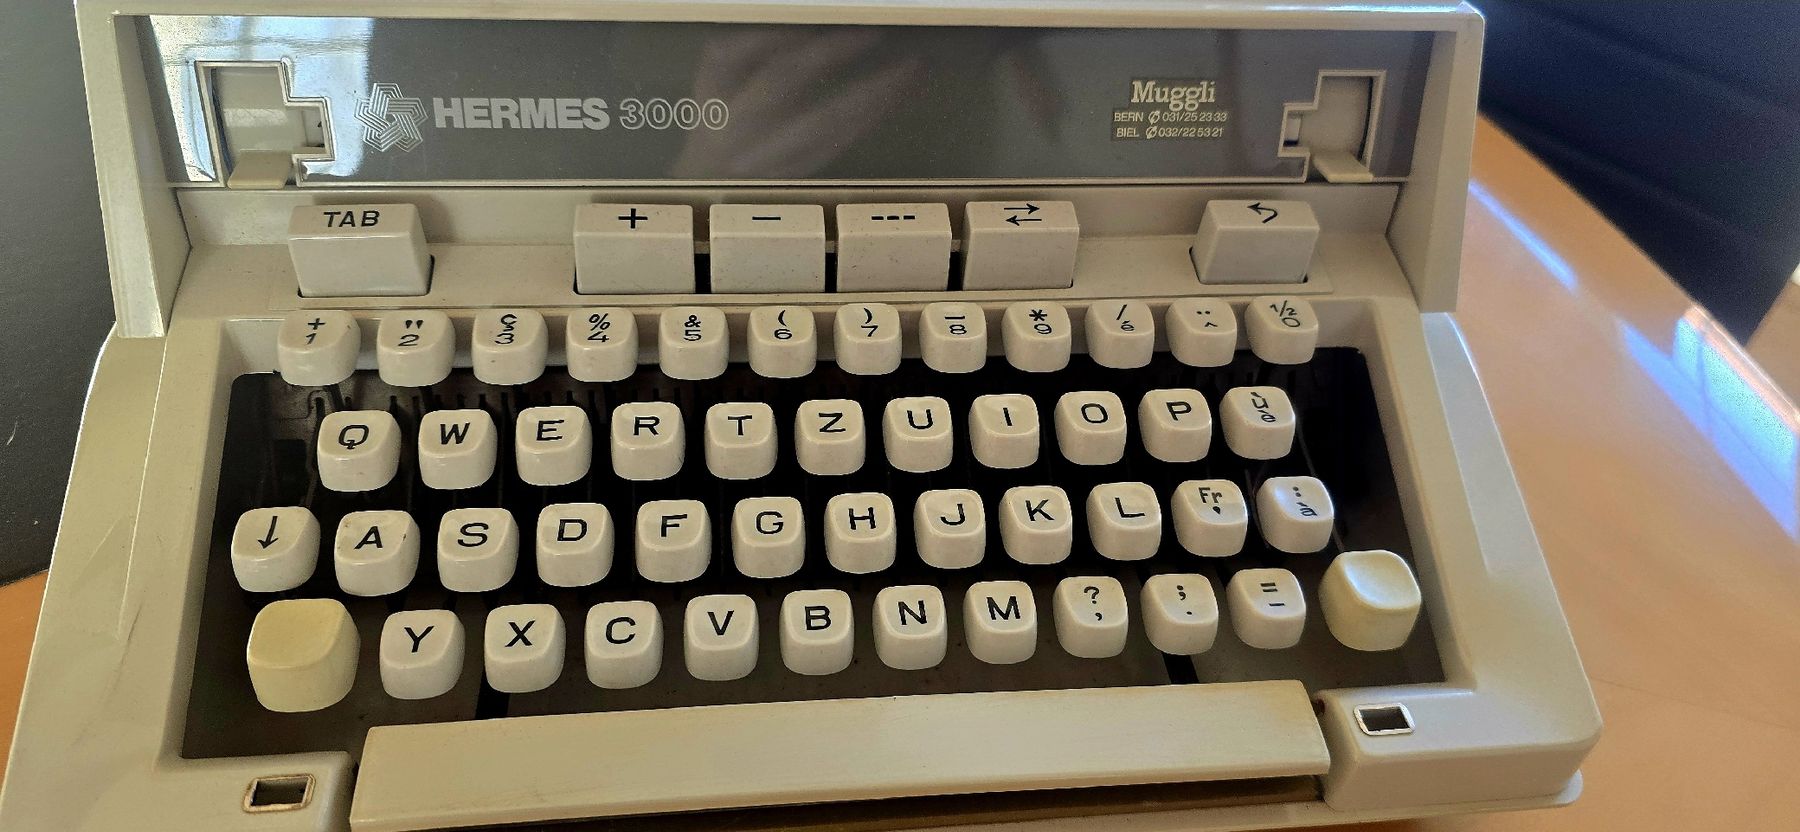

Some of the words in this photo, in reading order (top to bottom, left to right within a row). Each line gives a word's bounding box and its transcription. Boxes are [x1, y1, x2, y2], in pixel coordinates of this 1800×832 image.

[1130, 79, 1216, 112] Muggli
[432, 96, 611, 130] HERMES
[619, 96, 730, 131] 3000
[1113, 111, 1144, 122] BERN
[1116, 127, 1140, 138] BIEL
[324, 211, 379, 227] TAB
[589, 313, 610, 331] %
[684, 315, 701, 327] &
[861, 325, 878, 337] 7
[949, 325, 967, 335] 8
[1034, 324, 1052, 334] 9
[1118, 319, 1134, 331] é
[306, 333, 316, 344] 1
[398, 334, 419, 346] 2
[495, 331, 514, 344] 3
[588, 330, 609, 342] 4
[684, 330, 701, 341] 5
[774, 329, 792, 339] 6
[907, 409, 933, 429] U
[1003, 408, 1012, 426] I
[1081, 404, 1108, 423] O
[1166, 402, 1191, 421] P
[537, 420, 564, 441] E
[633, 416, 660, 435] R
[728, 415, 752, 435] T
[819, 413, 846, 432] Z
[339, 425, 369, 449] Q
[440, 423, 470, 444] W
[1199, 488, 1222, 507] Fr
[941, 504, 965, 525] J
[1026, 500, 1054, 521] K
[1115, 498, 1145, 518] L
[661, 514, 687, 537] F
[756, 511, 783, 534] G
[849, 507, 876, 530] H
[354, 526, 382, 549] A
[458, 523, 488, 547] S
[557, 519, 587, 541] D
[1084, 586, 1099, 604] ?
[805, 606, 831, 630] B
[898, 600, 927, 625] N
[987, 596, 1020, 620] M
[606, 617, 635, 644] C
[708, 610, 734, 635] V
[404, 626, 434, 653] Y
[505, 621, 535, 647] X
